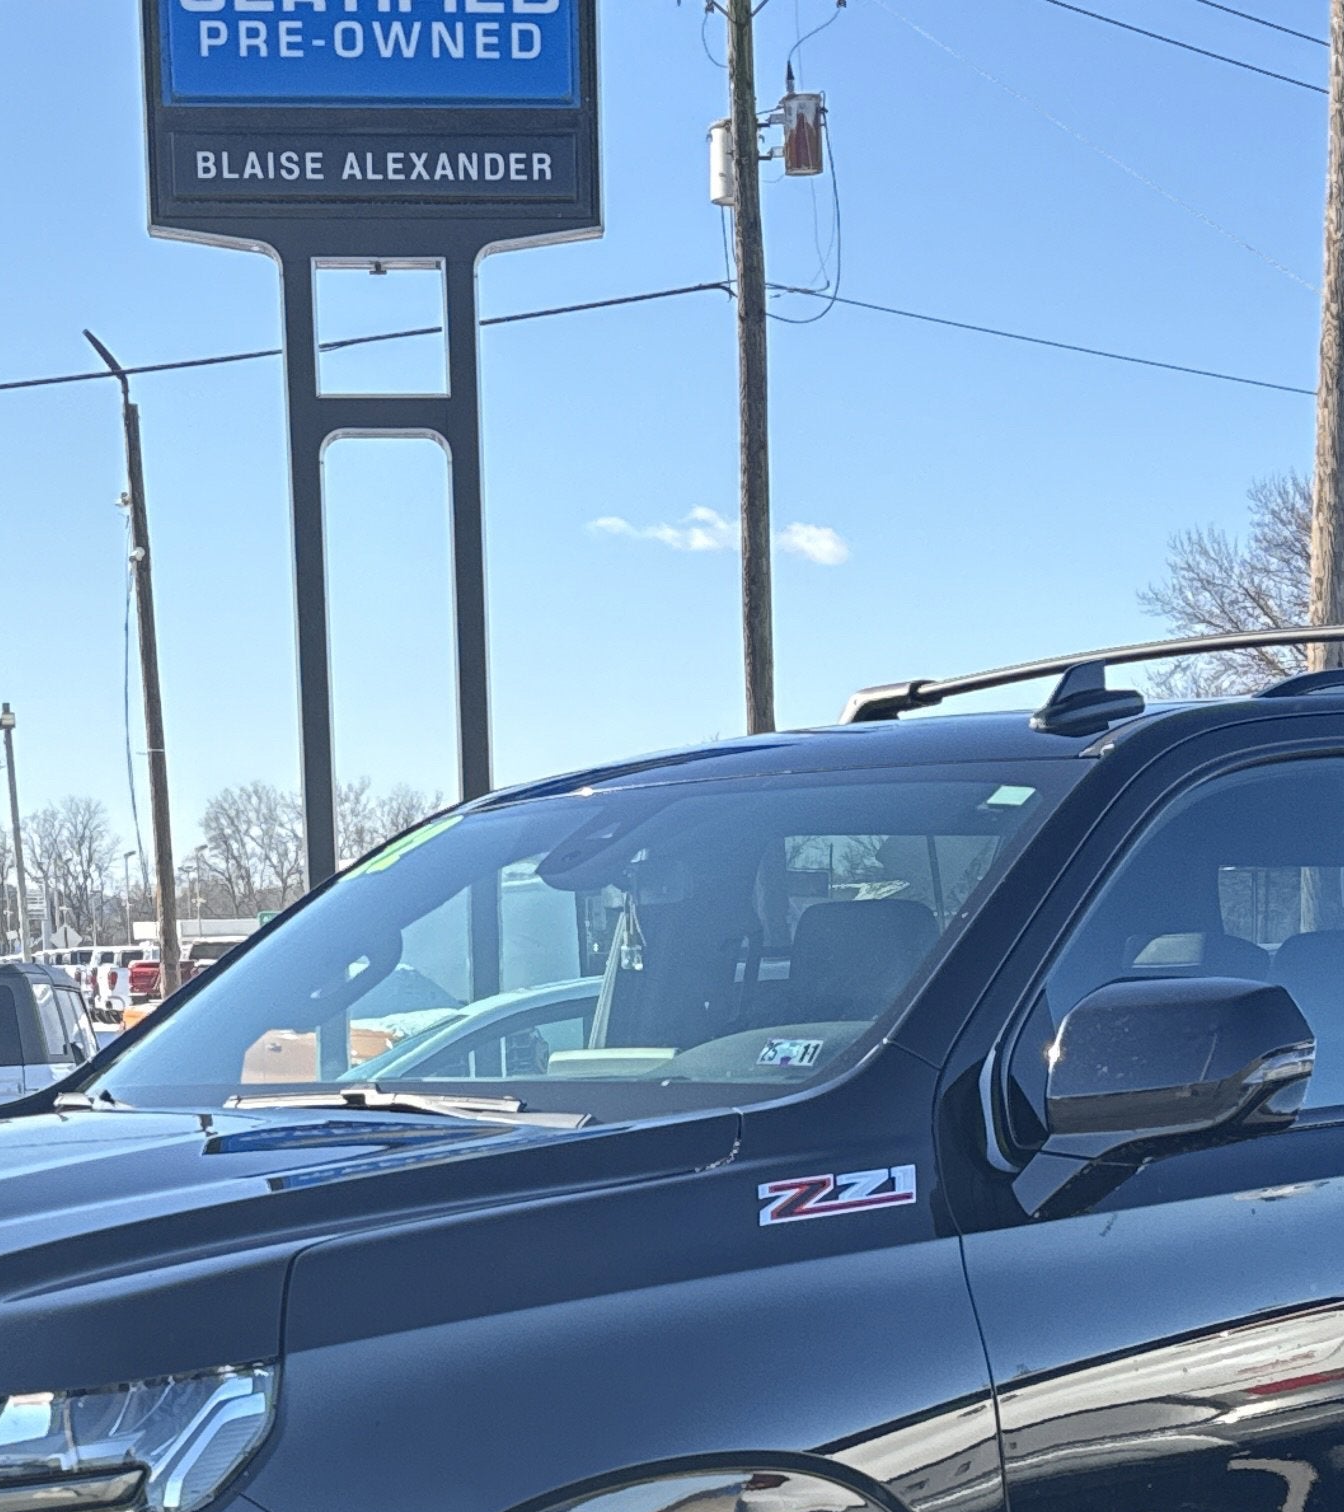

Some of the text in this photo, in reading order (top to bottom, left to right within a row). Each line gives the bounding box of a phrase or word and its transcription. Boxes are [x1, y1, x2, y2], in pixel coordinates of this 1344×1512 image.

[199, 20, 541, 59] PRE-OWNED
[196, 151, 552, 180] BLAISE ALEXANDER
[760, 1042, 783, 1061] 25
[758, 1164, 916, 1226] Z71
